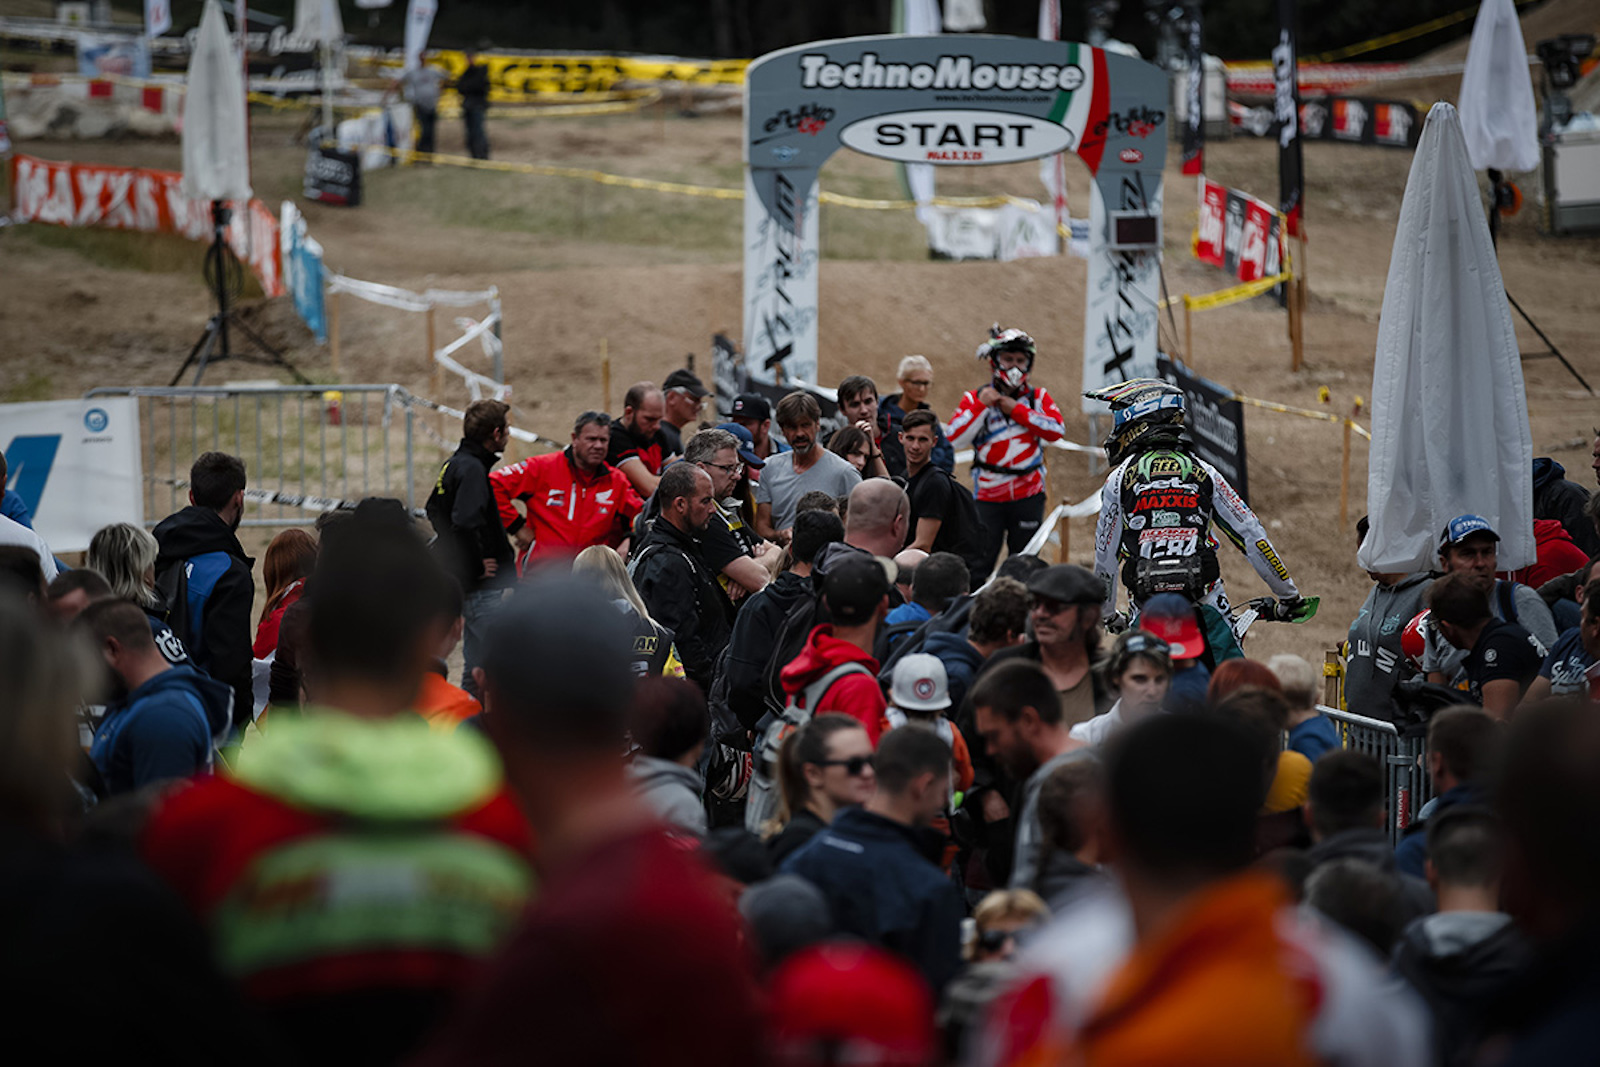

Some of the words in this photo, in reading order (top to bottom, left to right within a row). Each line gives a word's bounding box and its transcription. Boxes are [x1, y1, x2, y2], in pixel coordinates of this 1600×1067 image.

[801, 53, 1084, 91] TechnoMousse
[876, 123, 1033, 147] START
[1133, 495, 1199, 513] MAXXIS
